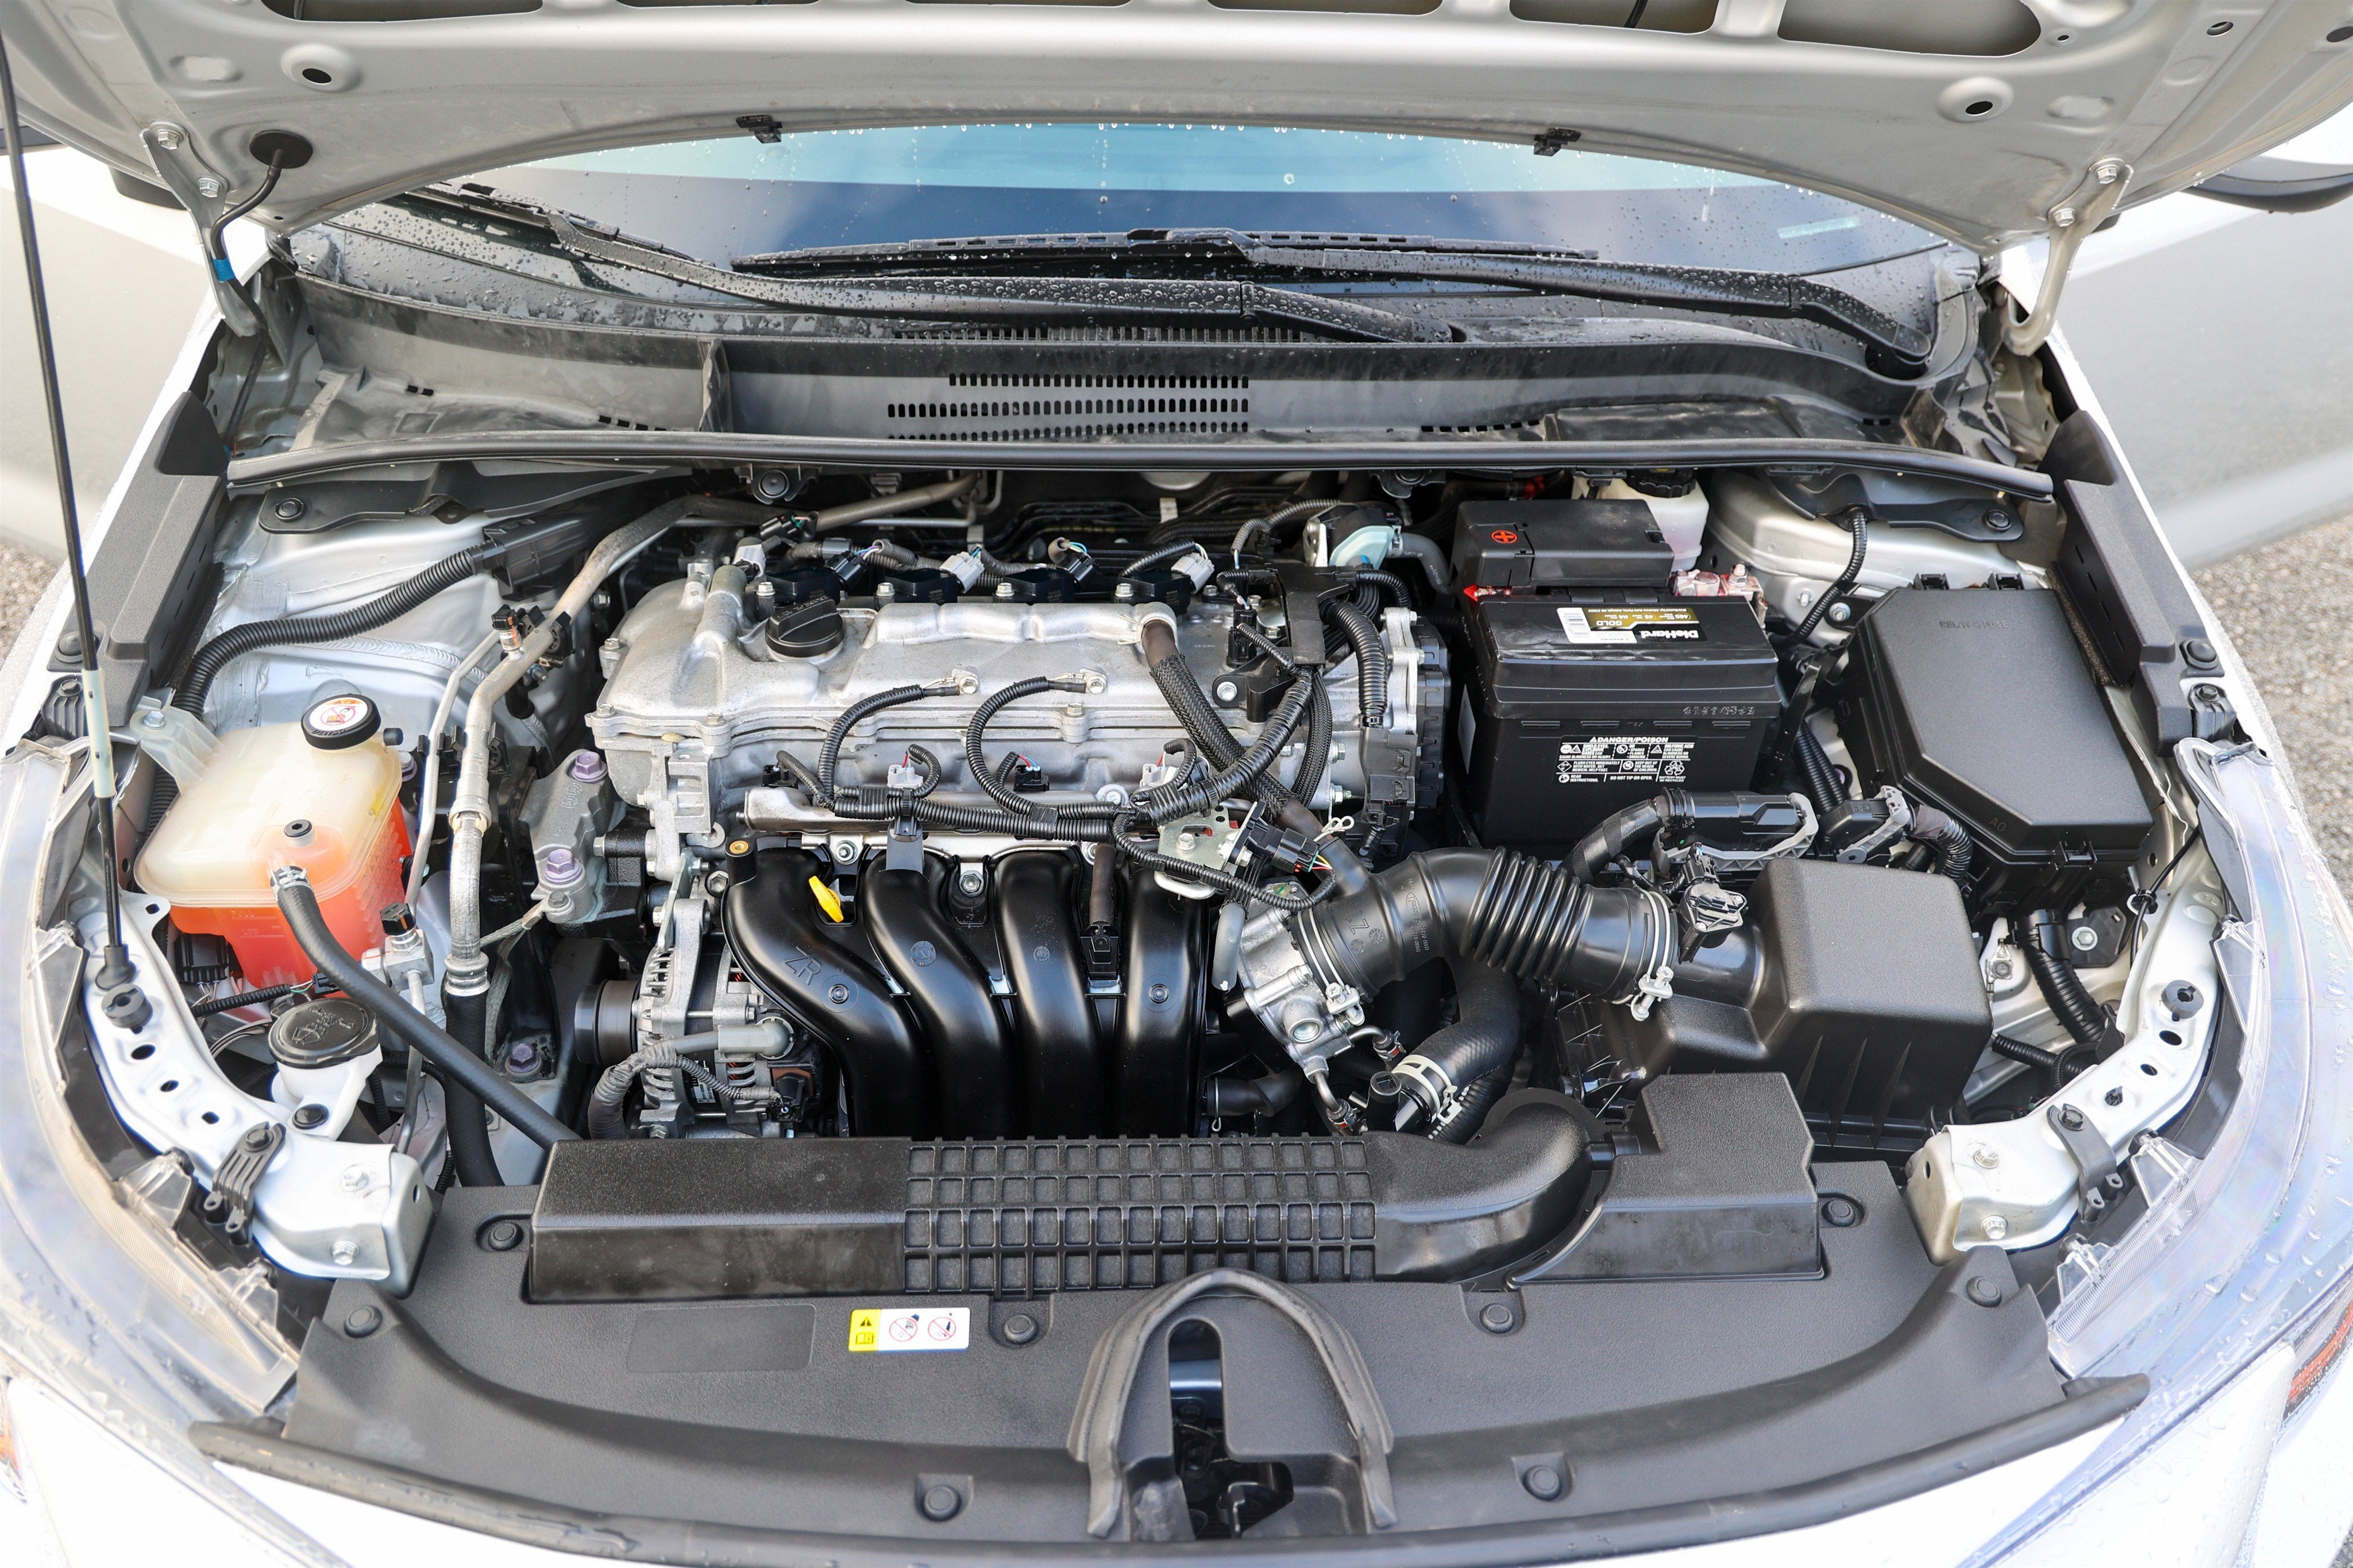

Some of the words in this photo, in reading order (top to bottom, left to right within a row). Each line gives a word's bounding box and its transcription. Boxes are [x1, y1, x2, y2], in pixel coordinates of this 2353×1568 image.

[1984, 620, 2008, 628] FUSE
[1641, 630, 1699, 639] DieHard
[782, 946, 822, 986] ZR
